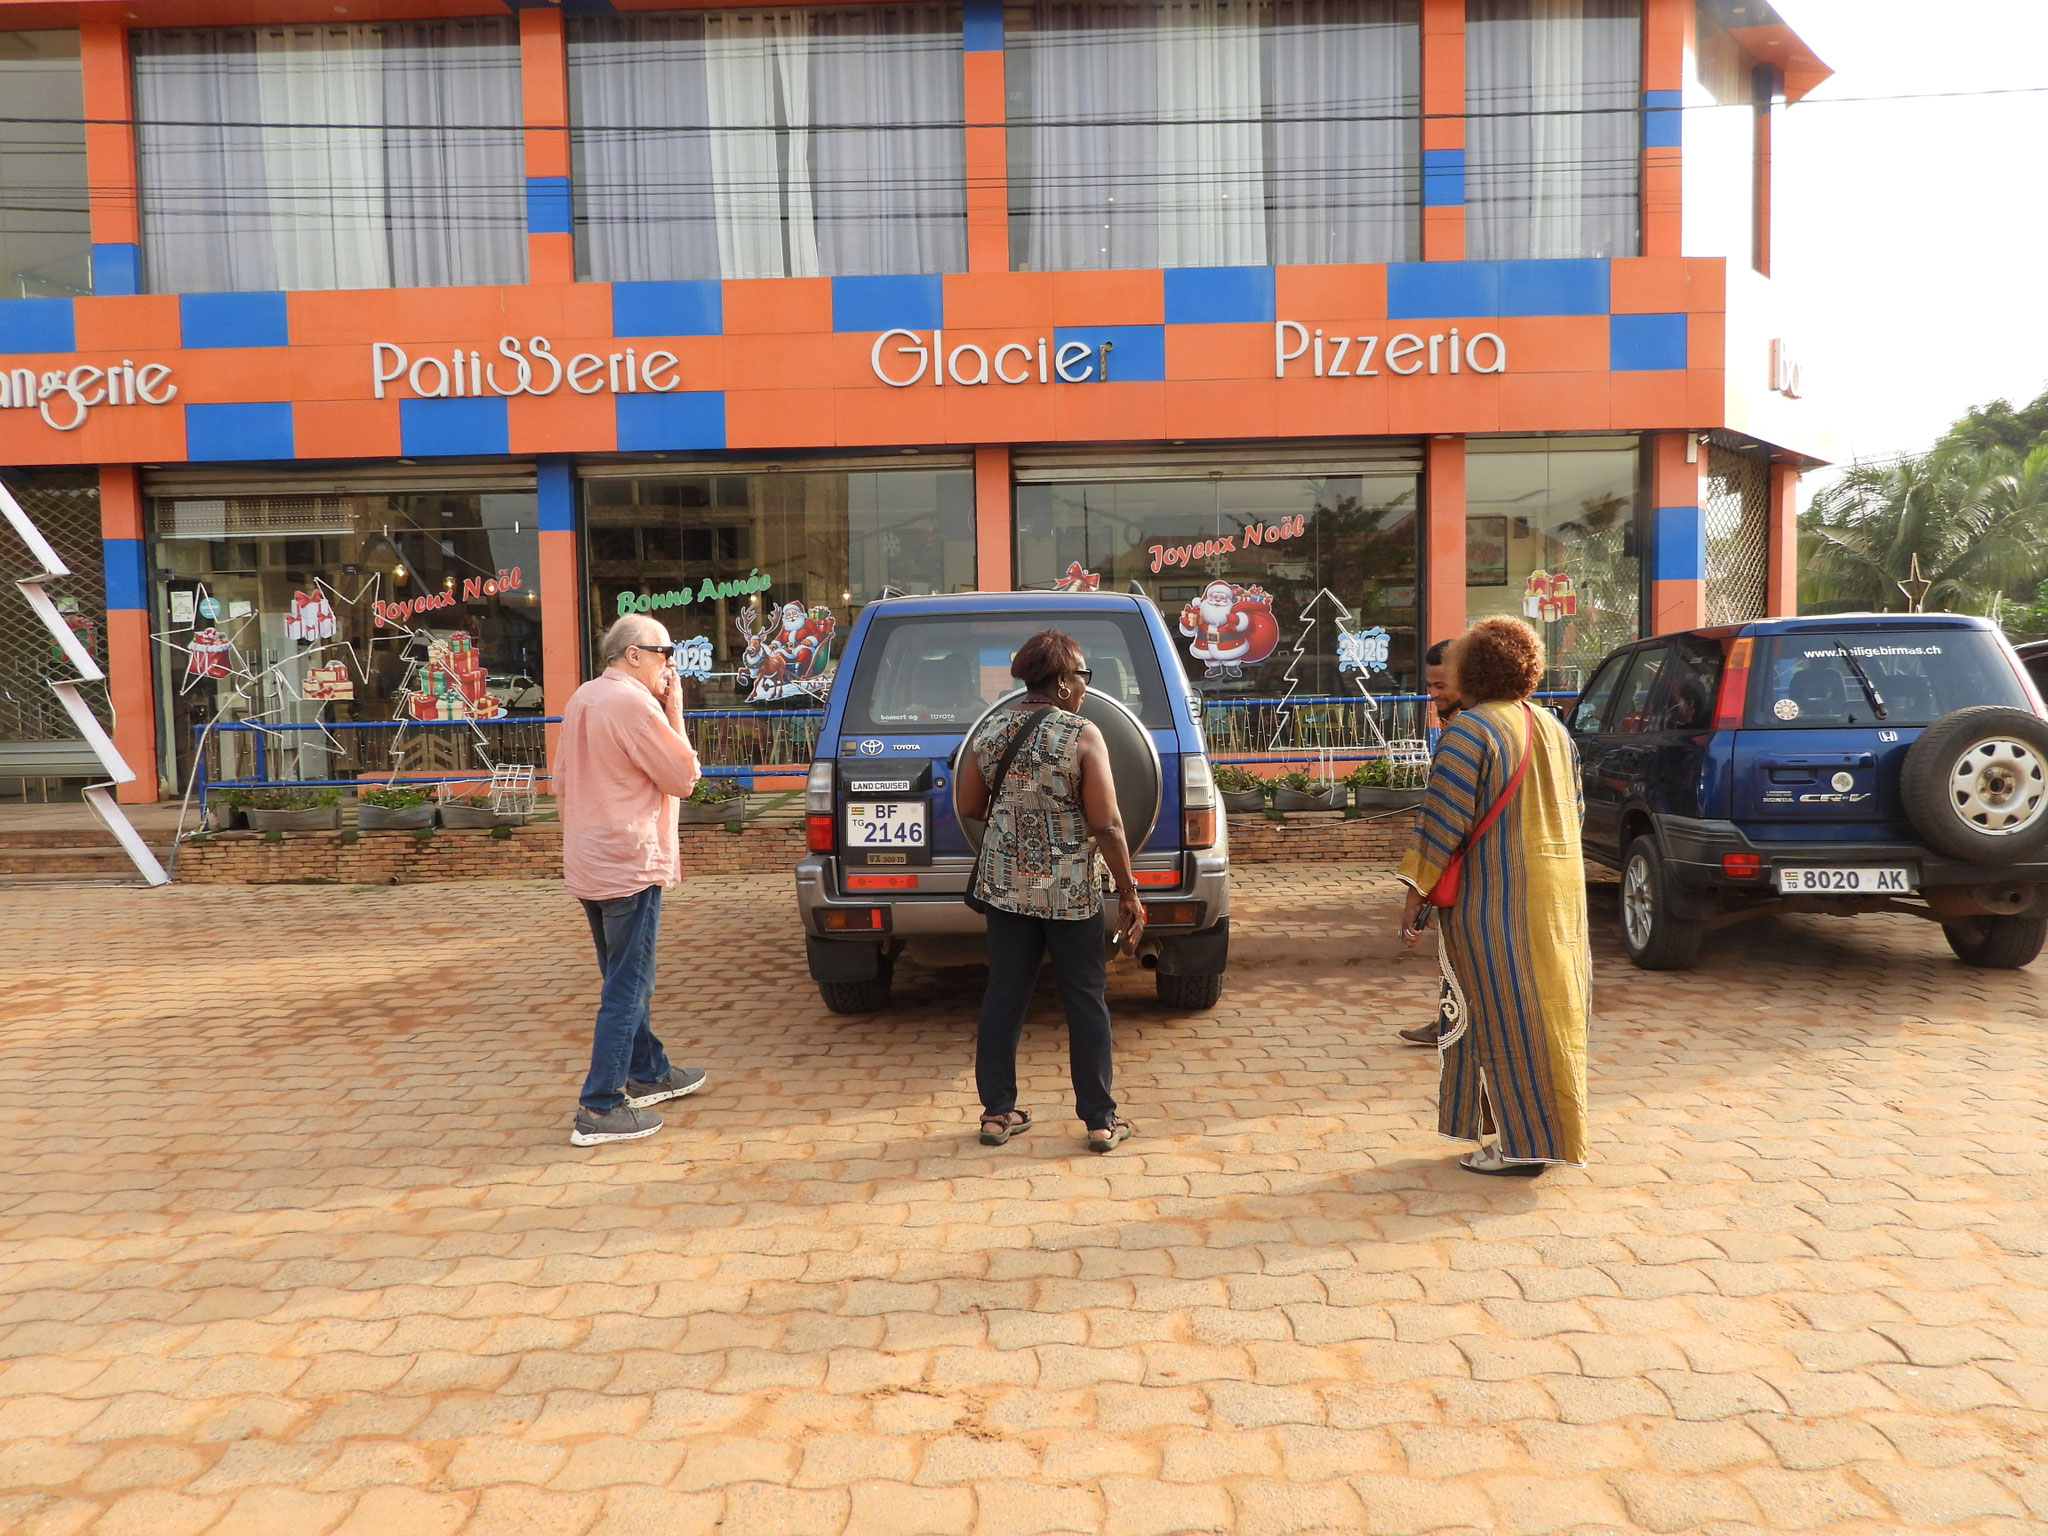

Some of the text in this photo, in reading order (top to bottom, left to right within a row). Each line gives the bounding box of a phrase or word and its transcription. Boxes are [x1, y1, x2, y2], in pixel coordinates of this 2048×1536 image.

[871, 328, 1113, 387] Glacier
[1275, 320, 1506, 377] Pizzeria
[1149, 514, 1305, 573] Joyeux Noël
[372, 567, 522, 628] Joyeux Noël
[617, 568, 772, 617] Bonne Année
[674, 647, 713, 671] 026
[1339, 638, 1389, 662] 2026
[875, 782, 908, 790] CRUISER
[1799, 793, 1871, 802] CR-V
[852, 819, 864, 827] TG
[876, 805, 898, 819] BF
[864, 822, 922, 843] 2146
[1787, 881, 1797, 889] TG
[1803, 871, 1904, 890] 8020 AK
